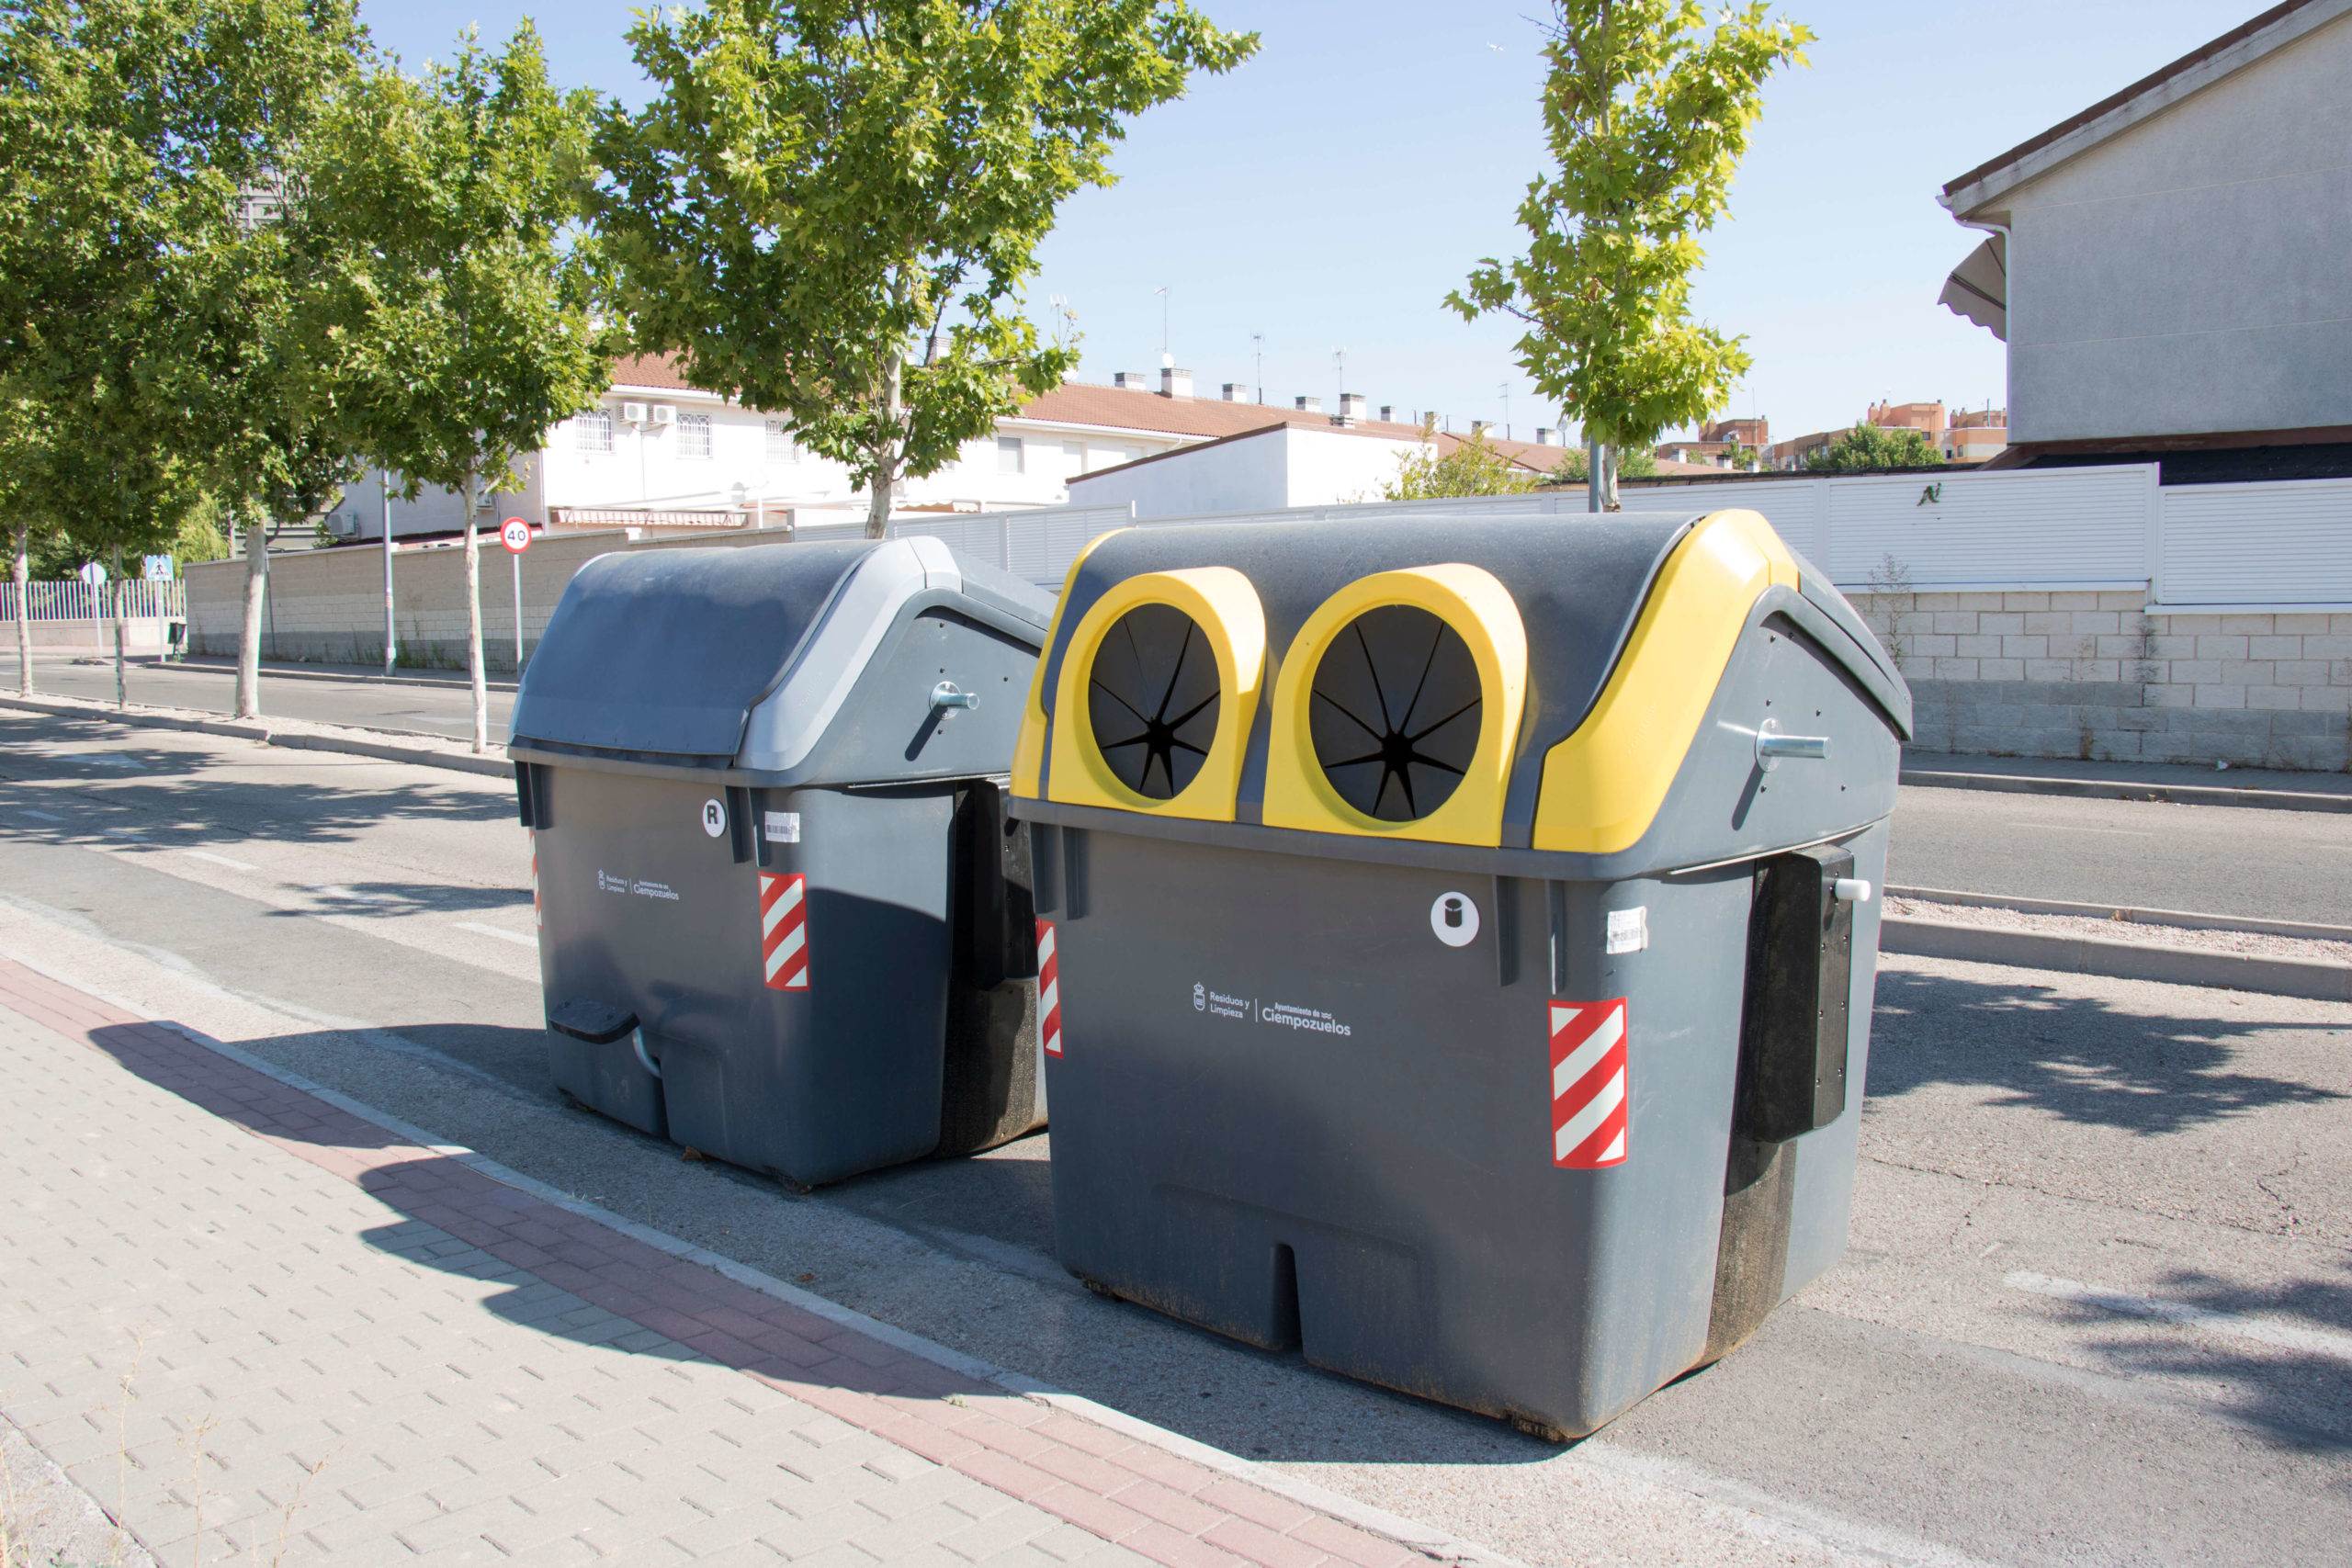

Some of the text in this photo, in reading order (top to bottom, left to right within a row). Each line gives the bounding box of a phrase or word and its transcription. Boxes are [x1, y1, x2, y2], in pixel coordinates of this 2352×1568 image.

[507, 530, 526, 541] 40
[707, 805, 718, 824] R
[633, 884, 679, 900] Ciempozuelos
[1210, 991, 1250, 1010] Residuos y
[1210, 1003, 1243, 1018] Limpieza
[1274, 1002, 1320, 1018] Ayuntamiento de
[1261, 1007, 1351, 1036] Ciempozuelos
